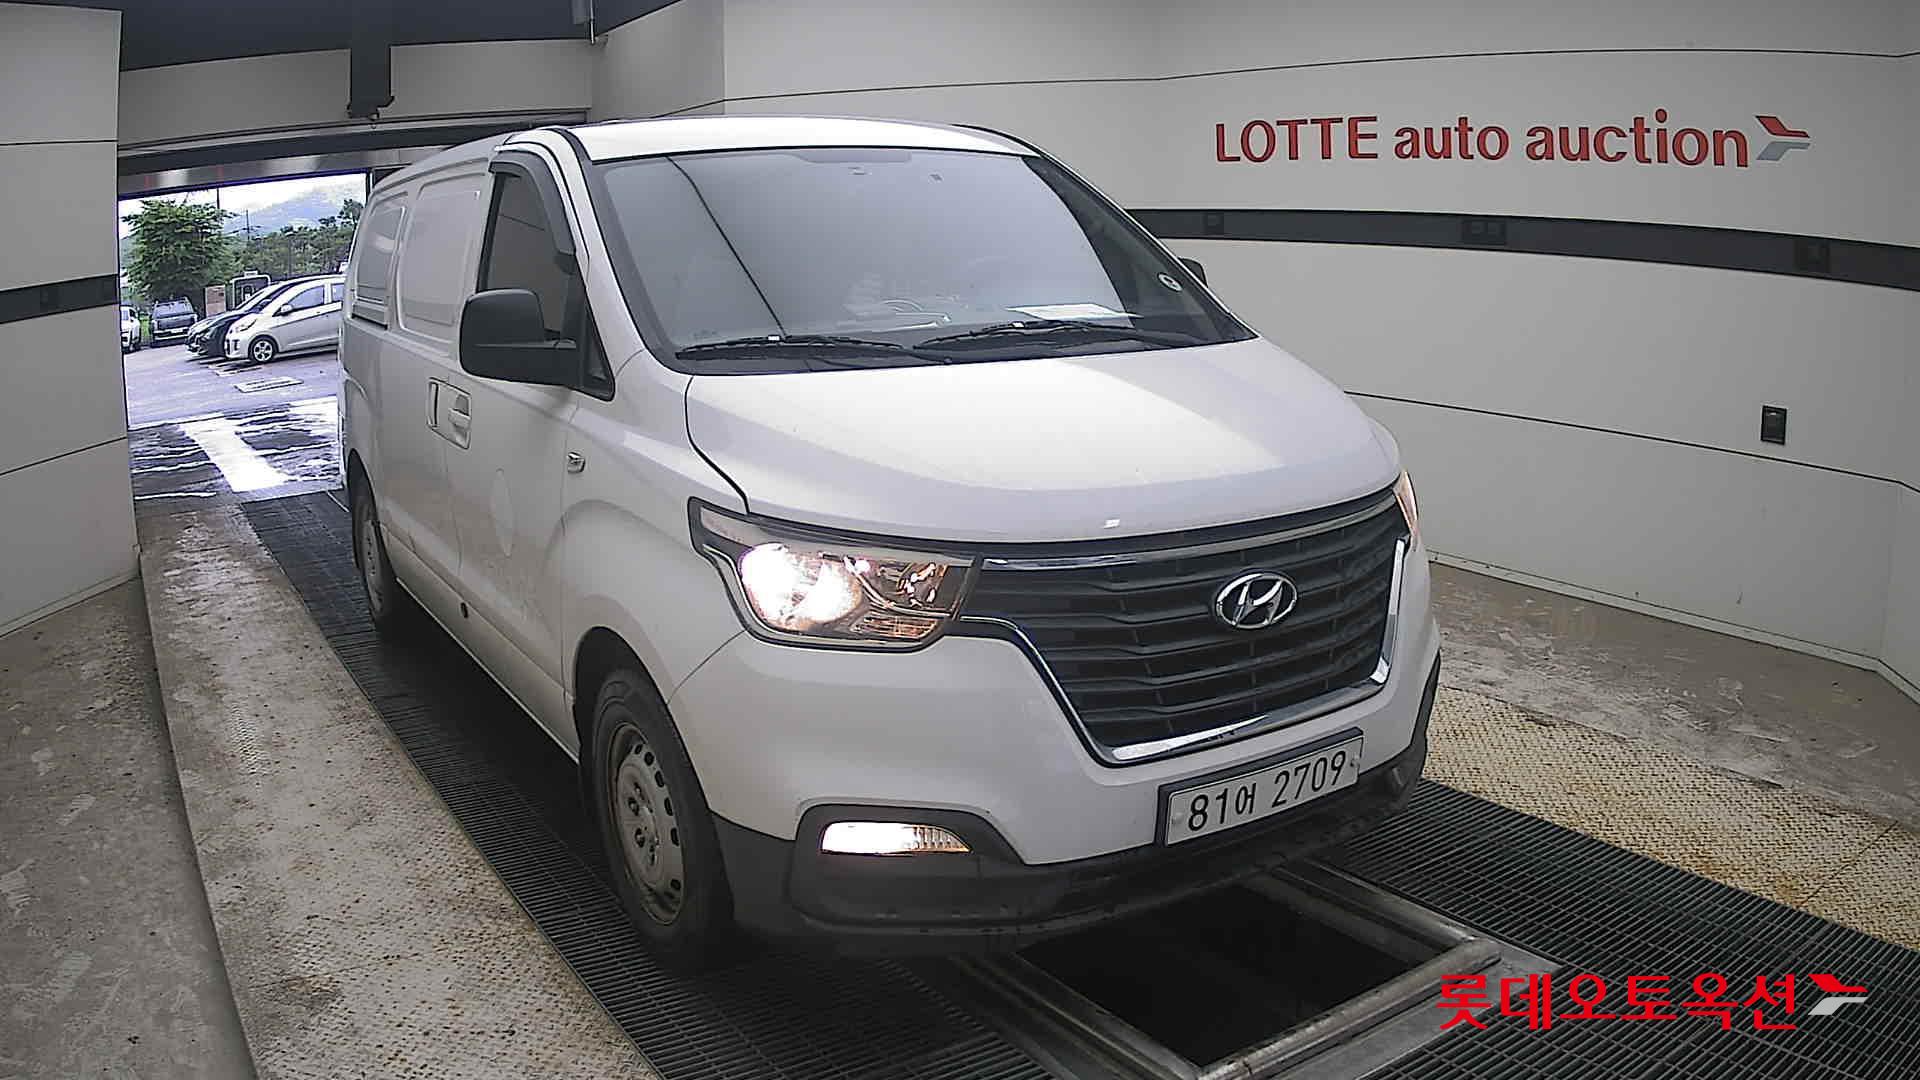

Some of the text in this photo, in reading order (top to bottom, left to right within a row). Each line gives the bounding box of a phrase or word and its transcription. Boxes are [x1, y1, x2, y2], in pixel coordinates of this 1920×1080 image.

[1215, 108, 1748, 168] LOTTE auto auction
[1187, 750, 1347, 831] 81어 2709
